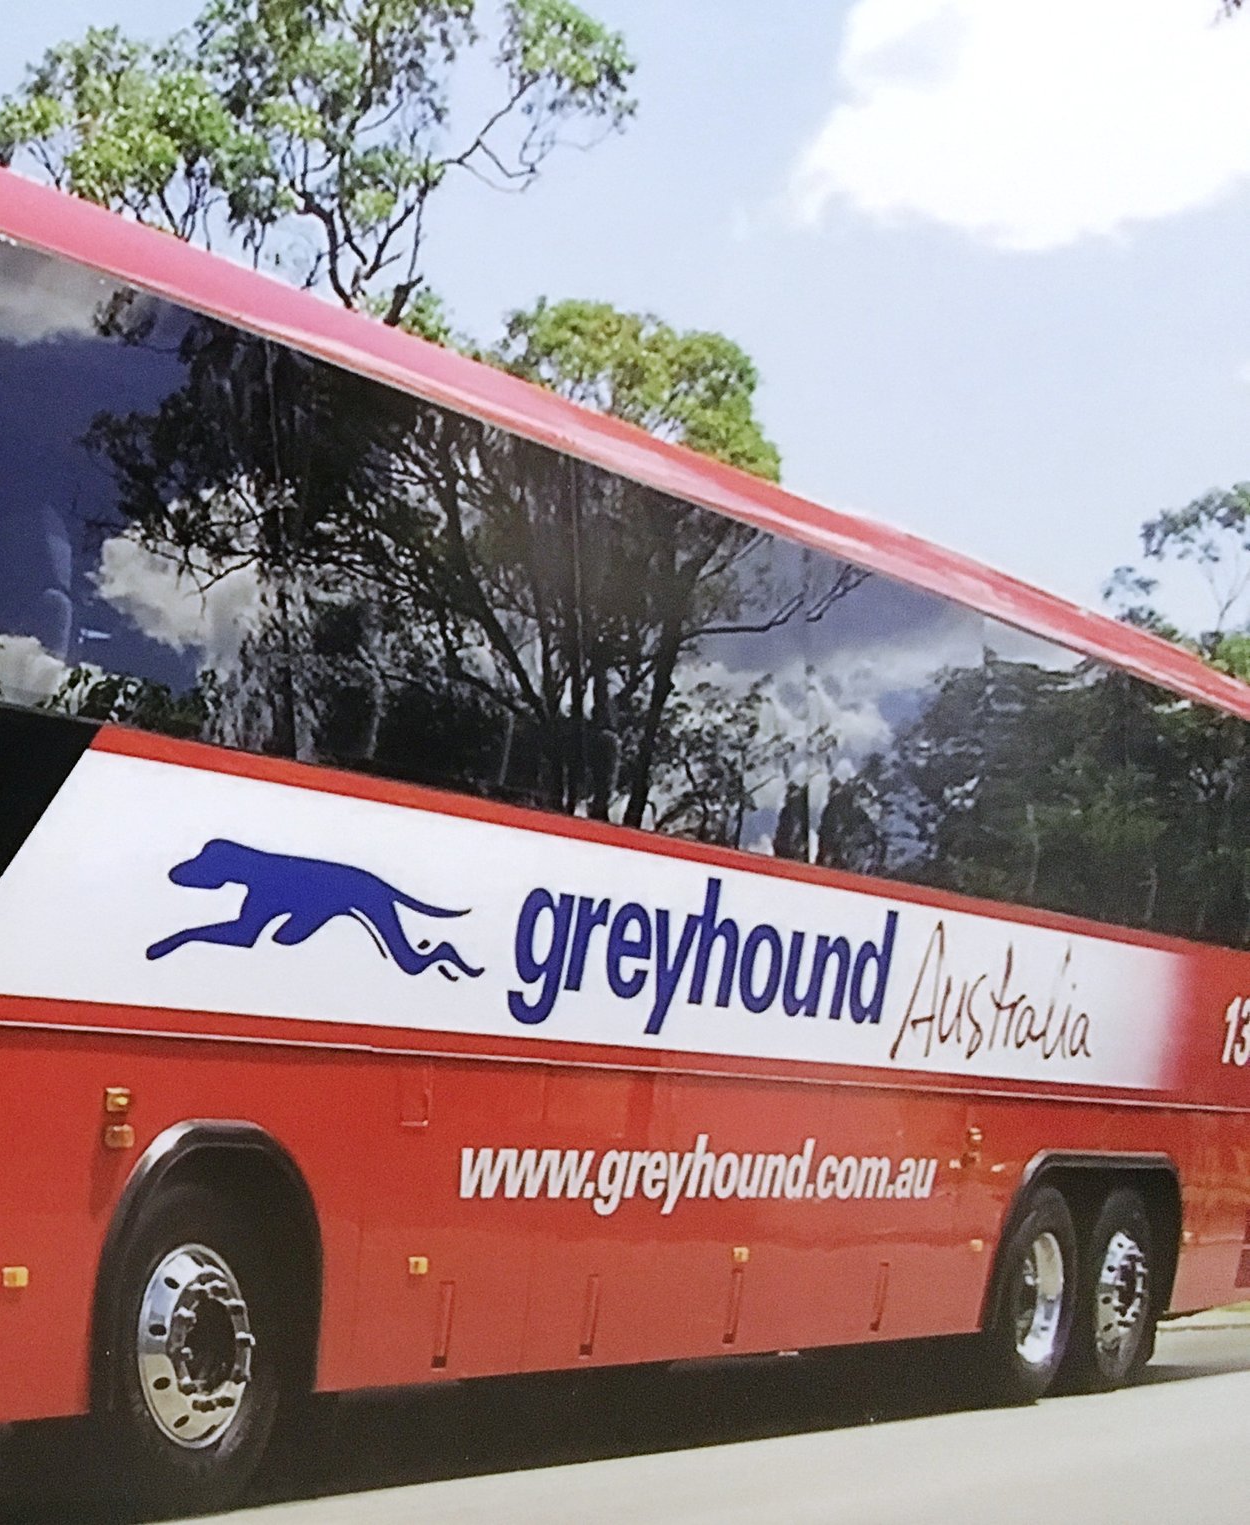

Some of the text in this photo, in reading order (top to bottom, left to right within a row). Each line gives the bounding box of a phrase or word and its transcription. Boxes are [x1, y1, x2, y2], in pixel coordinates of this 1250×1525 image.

[507, 877, 1093, 1061] greyhound Australia
[1221, 995, 1250, 1066] 13
[459, 1134, 938, 1216] www.greyhound.com.au
